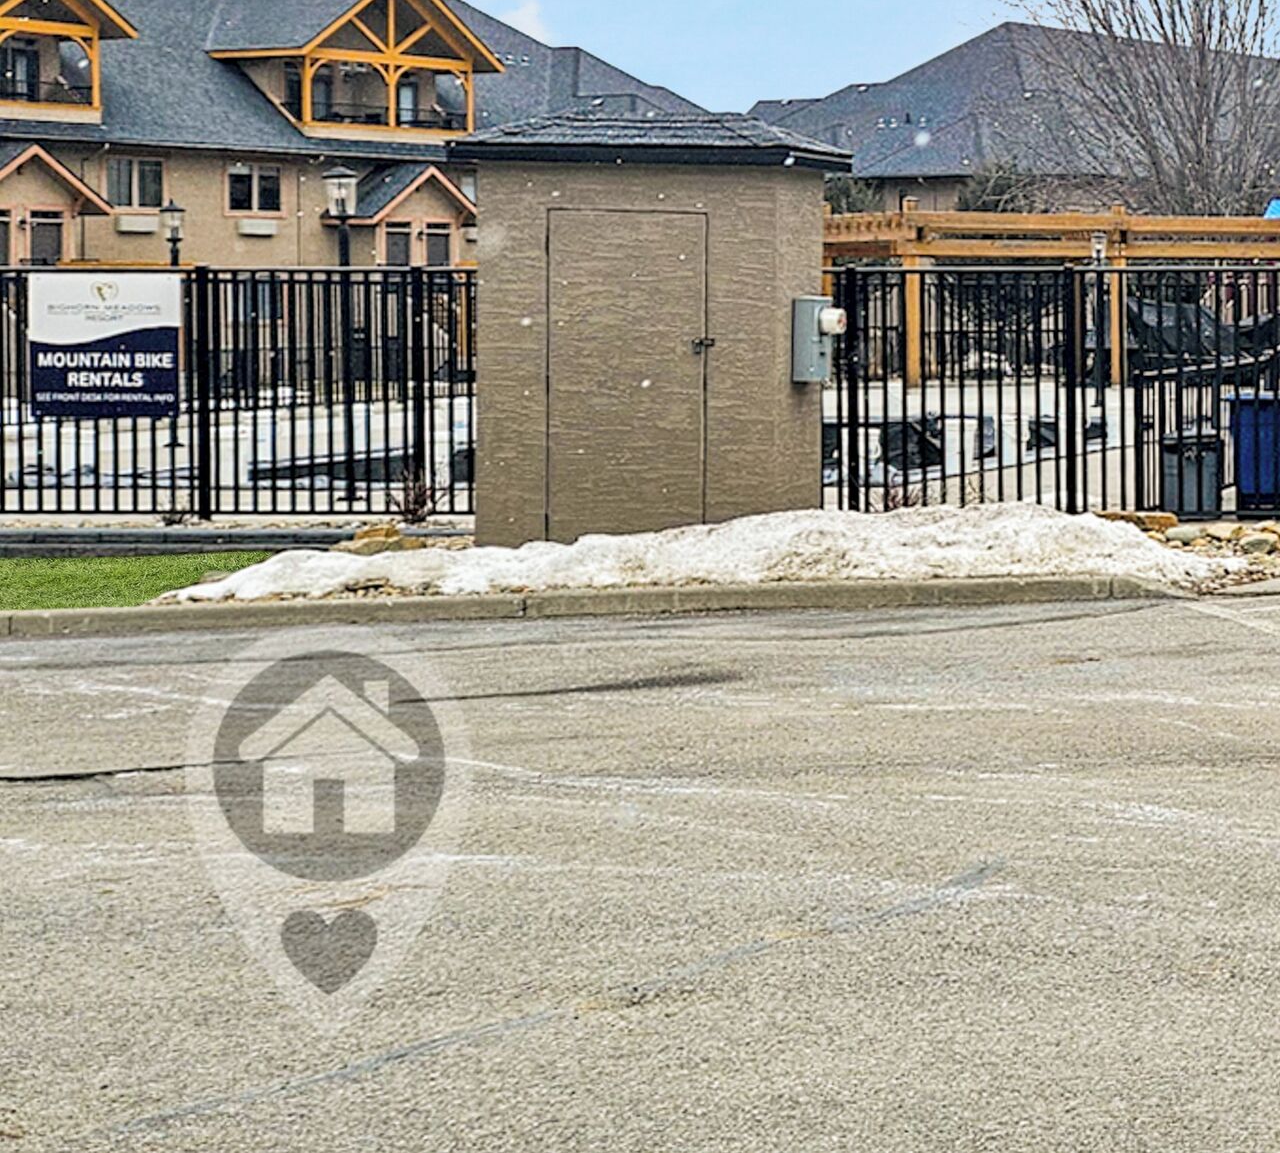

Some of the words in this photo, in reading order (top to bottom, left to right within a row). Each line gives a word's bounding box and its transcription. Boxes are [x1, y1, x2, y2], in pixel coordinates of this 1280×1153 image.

[37, 352, 131, 369] MOUNTAIN
[134, 352, 174, 368] BIKE
[67, 371, 144, 388] RENTALS
[35, 392, 51, 402] SEE
[52, 392, 80, 402] FRONT
[81, 392, 102, 402] DESK
[103, 392, 122, 402] FOR
[122, 392, 152, 402] RENTAL
[154, 393, 174, 402] INFO
